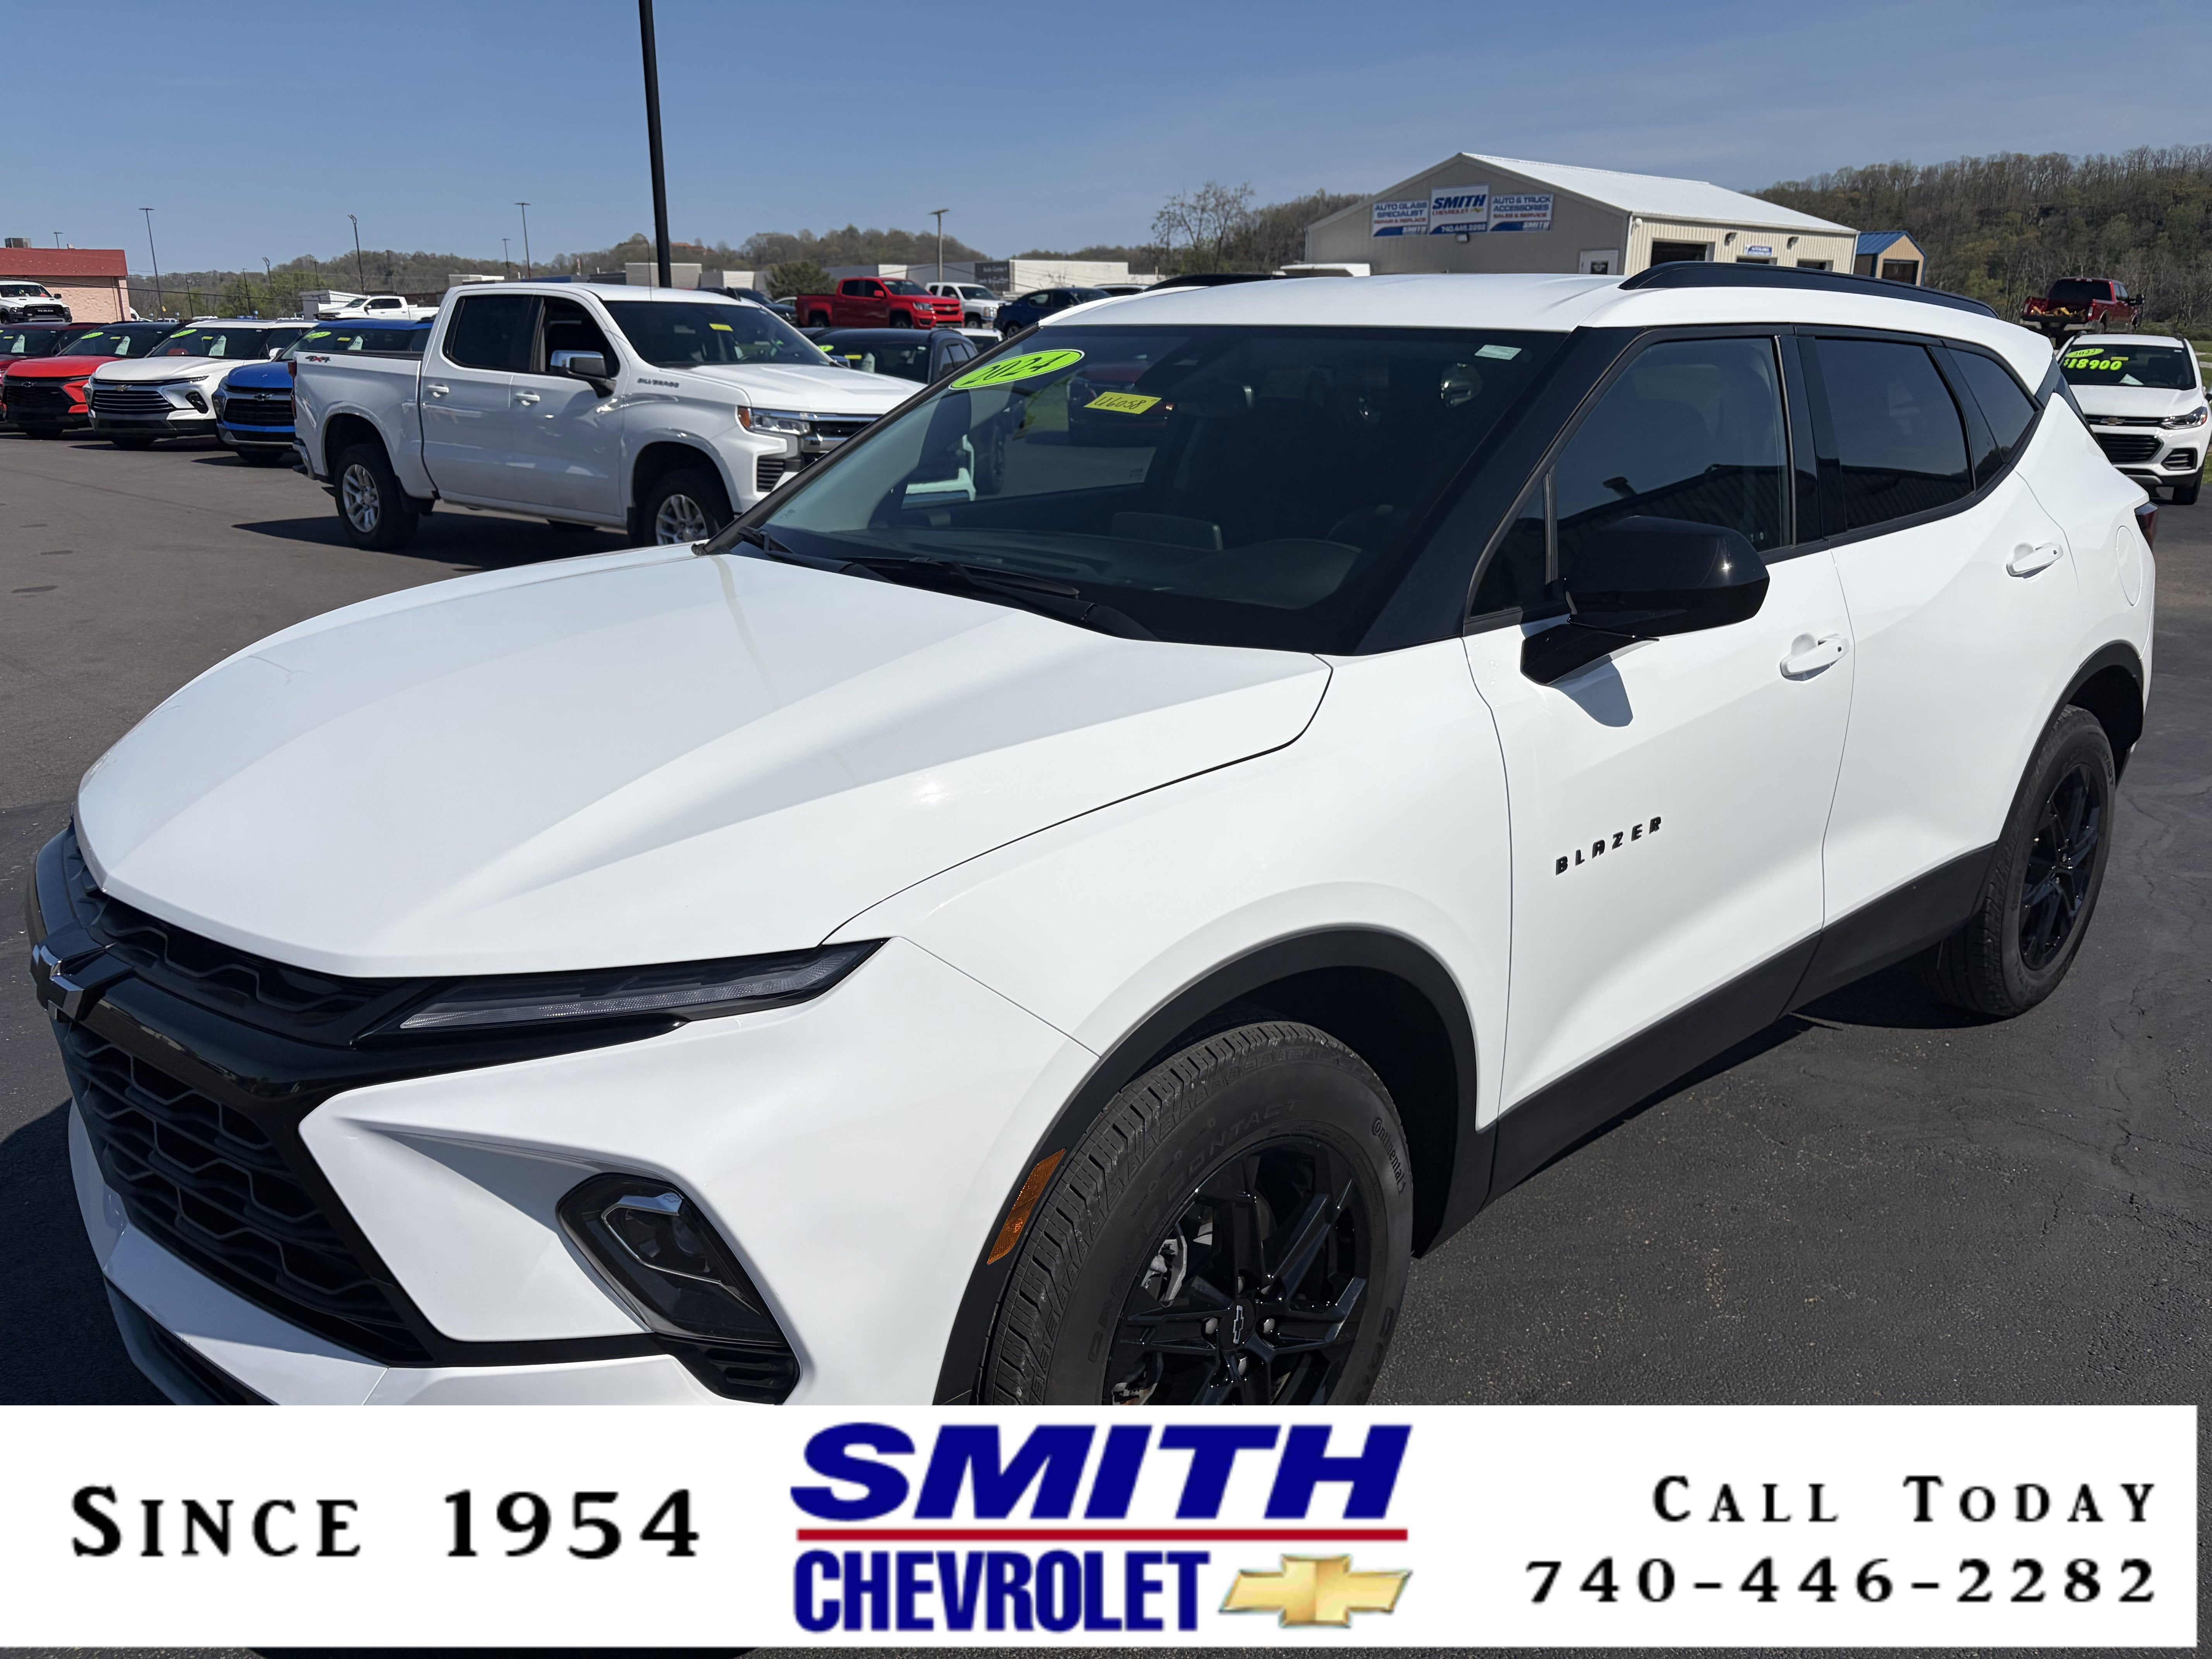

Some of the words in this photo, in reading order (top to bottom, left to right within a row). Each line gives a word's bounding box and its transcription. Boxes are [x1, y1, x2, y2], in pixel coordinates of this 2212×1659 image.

[1432, 194, 1486, 210] SMITH
[1523, 195, 1551, 203] TRUCK
[1377, 210, 1424, 218] SPECIALIST
[1493, 204, 1549, 212] ACCESSORIES
[959, 352, 1072, 386] 2024
[1555, 816, 1661, 876] BLAZER
